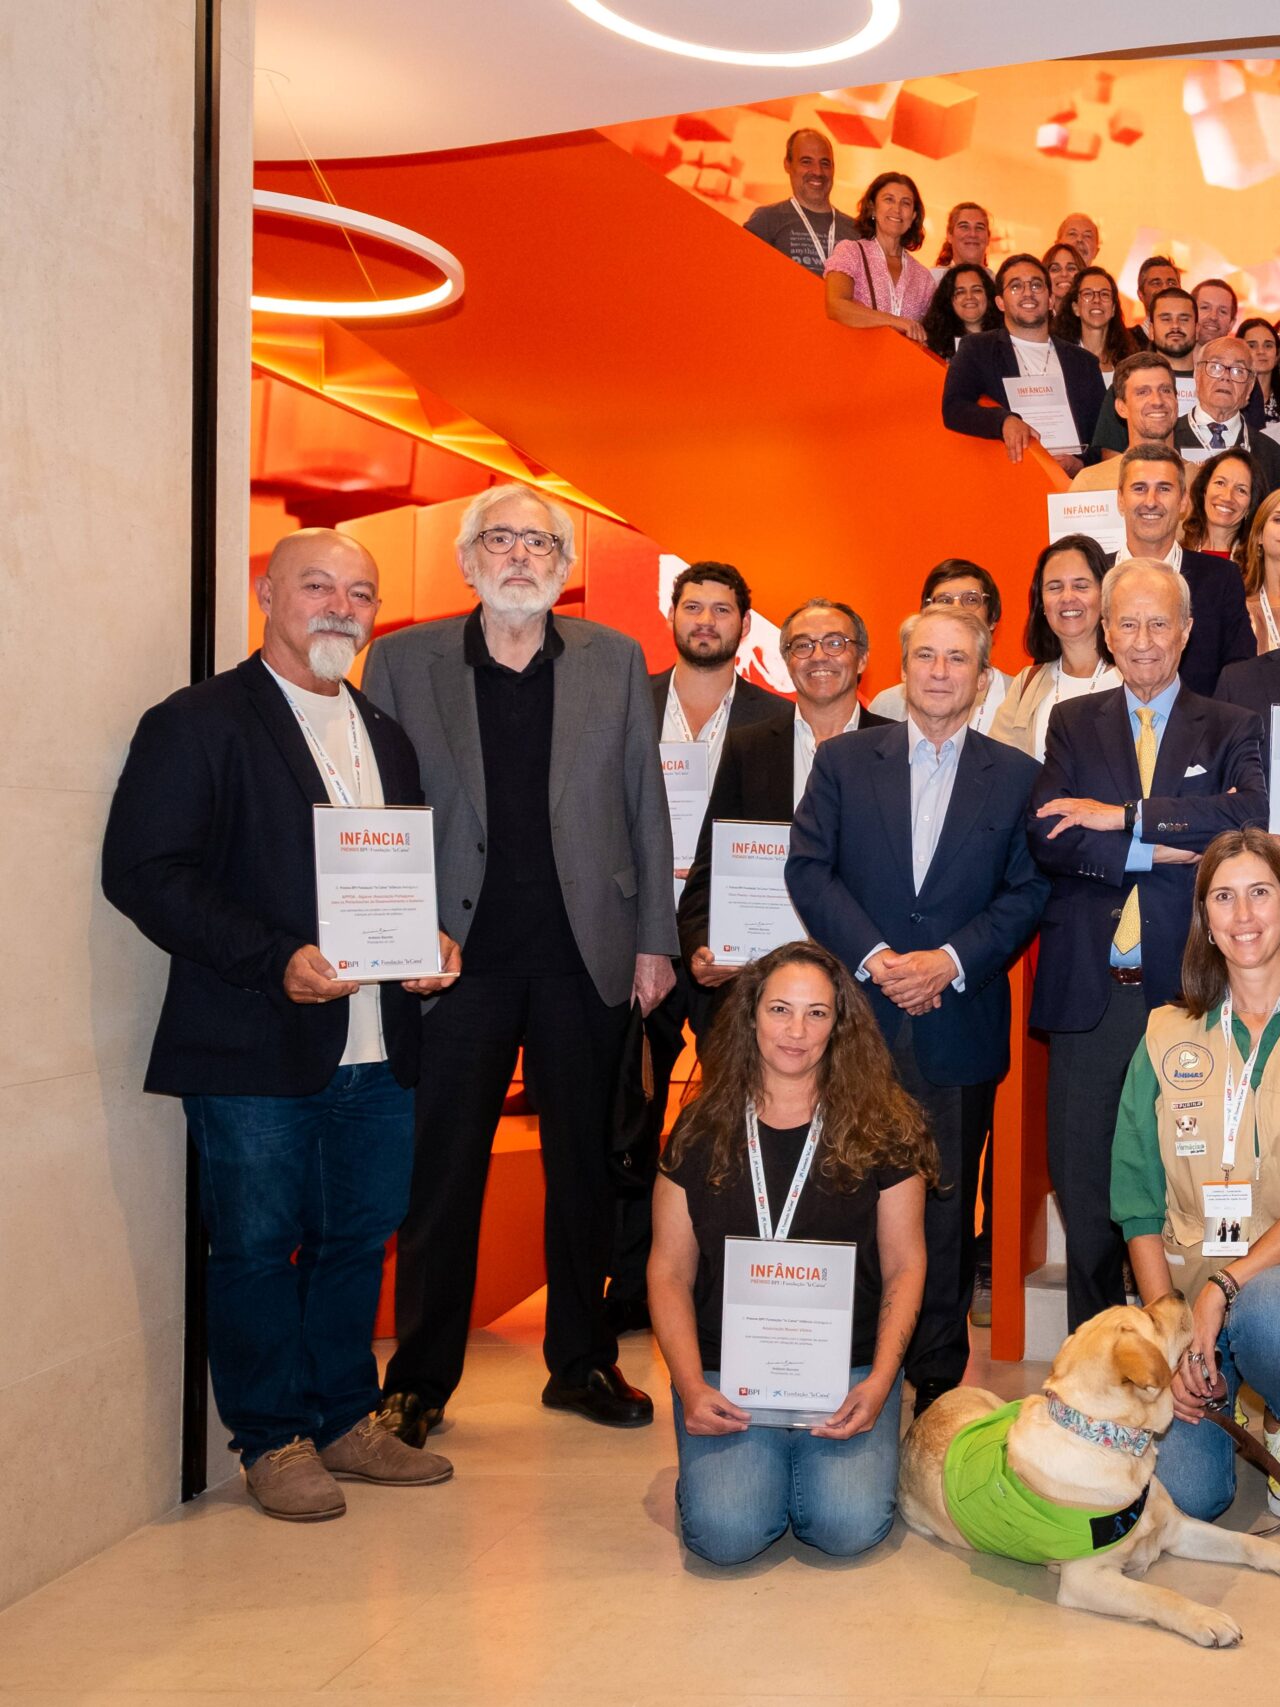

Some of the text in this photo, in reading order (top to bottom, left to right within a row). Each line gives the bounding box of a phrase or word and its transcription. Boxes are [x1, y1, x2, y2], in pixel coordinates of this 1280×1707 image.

[340, 829, 404, 845] INFÂNCIA
[732, 841, 785, 855] INFÂNCIA
[751, 1262, 820, 1280] INFÂNCIA
[748, 1388, 760, 1396] BPI
